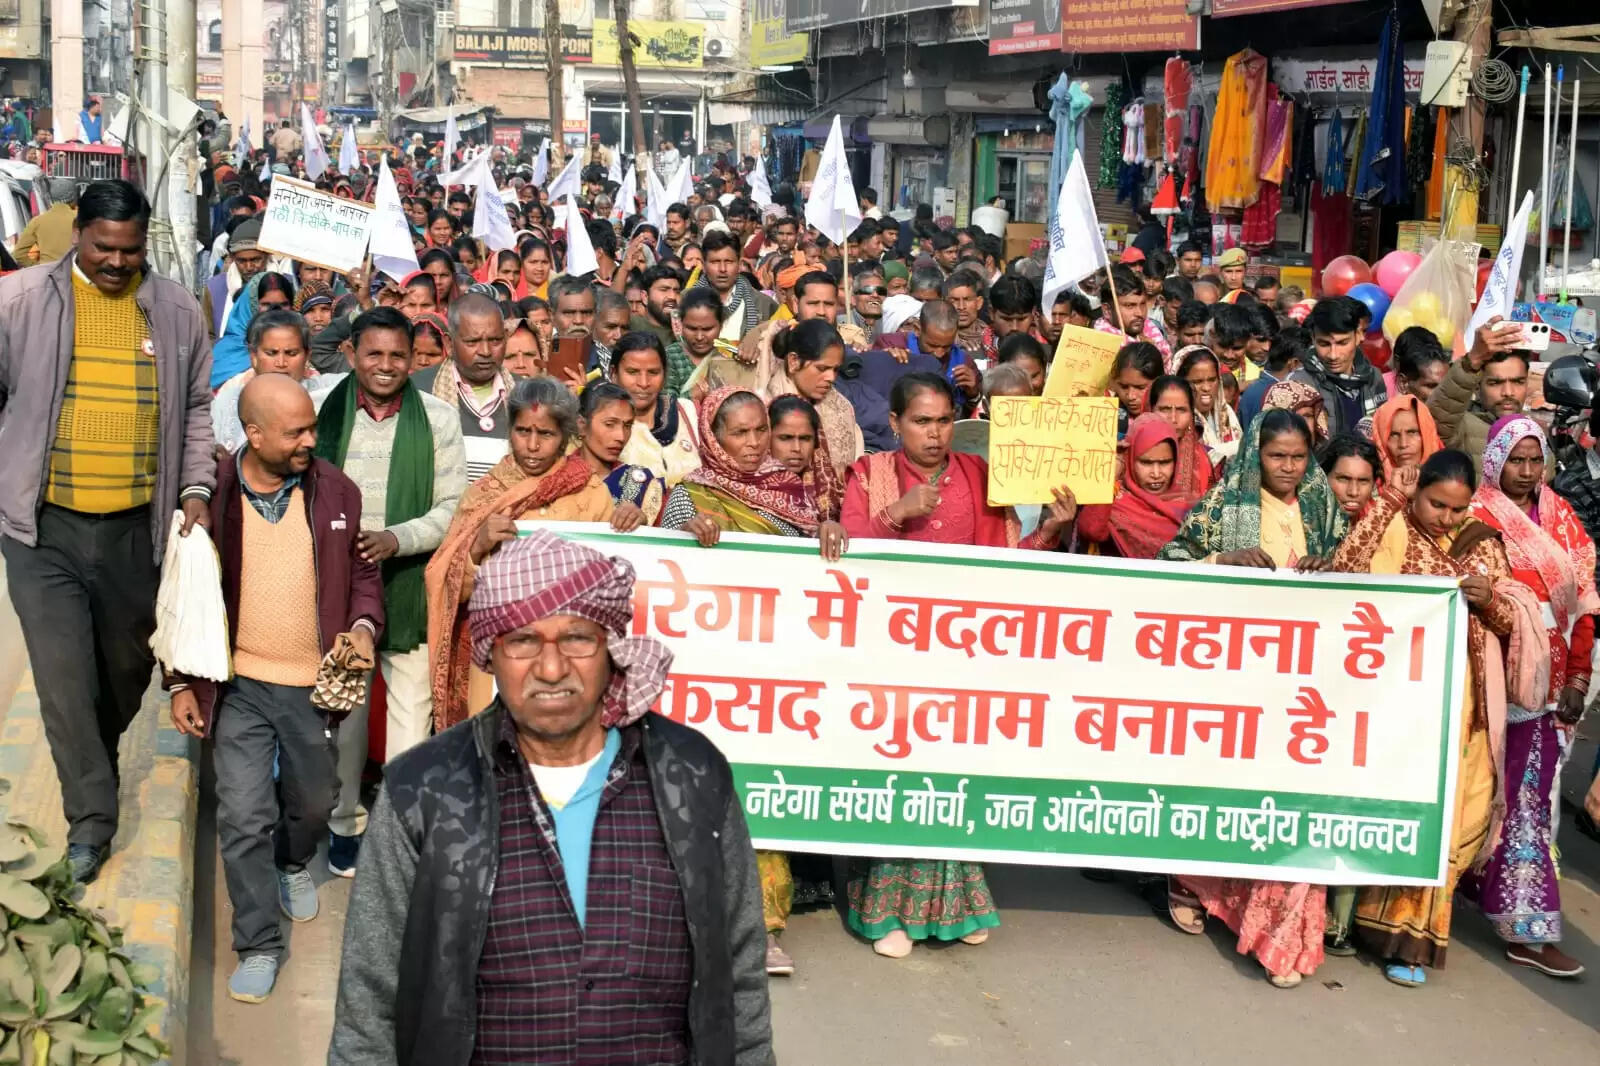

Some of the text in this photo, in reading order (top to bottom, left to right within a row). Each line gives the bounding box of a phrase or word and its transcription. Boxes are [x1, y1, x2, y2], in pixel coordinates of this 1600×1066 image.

[456, 33, 503, 51] BALAJI
[804, 569, 870, 648] में
[886, 595, 1112, 662] बदलाव
[1134, 611, 1321, 675] बहाना
[649, 672, 826, 740] कसद
[847, 683, 1051, 759] गुलाम
[1072, 695, 1264, 760] बनाना
[745, 770, 1421, 856] नरेगा संघर्ष मोर्चा, जन आंदोलनों का राष्ट्रीय समन्वय
